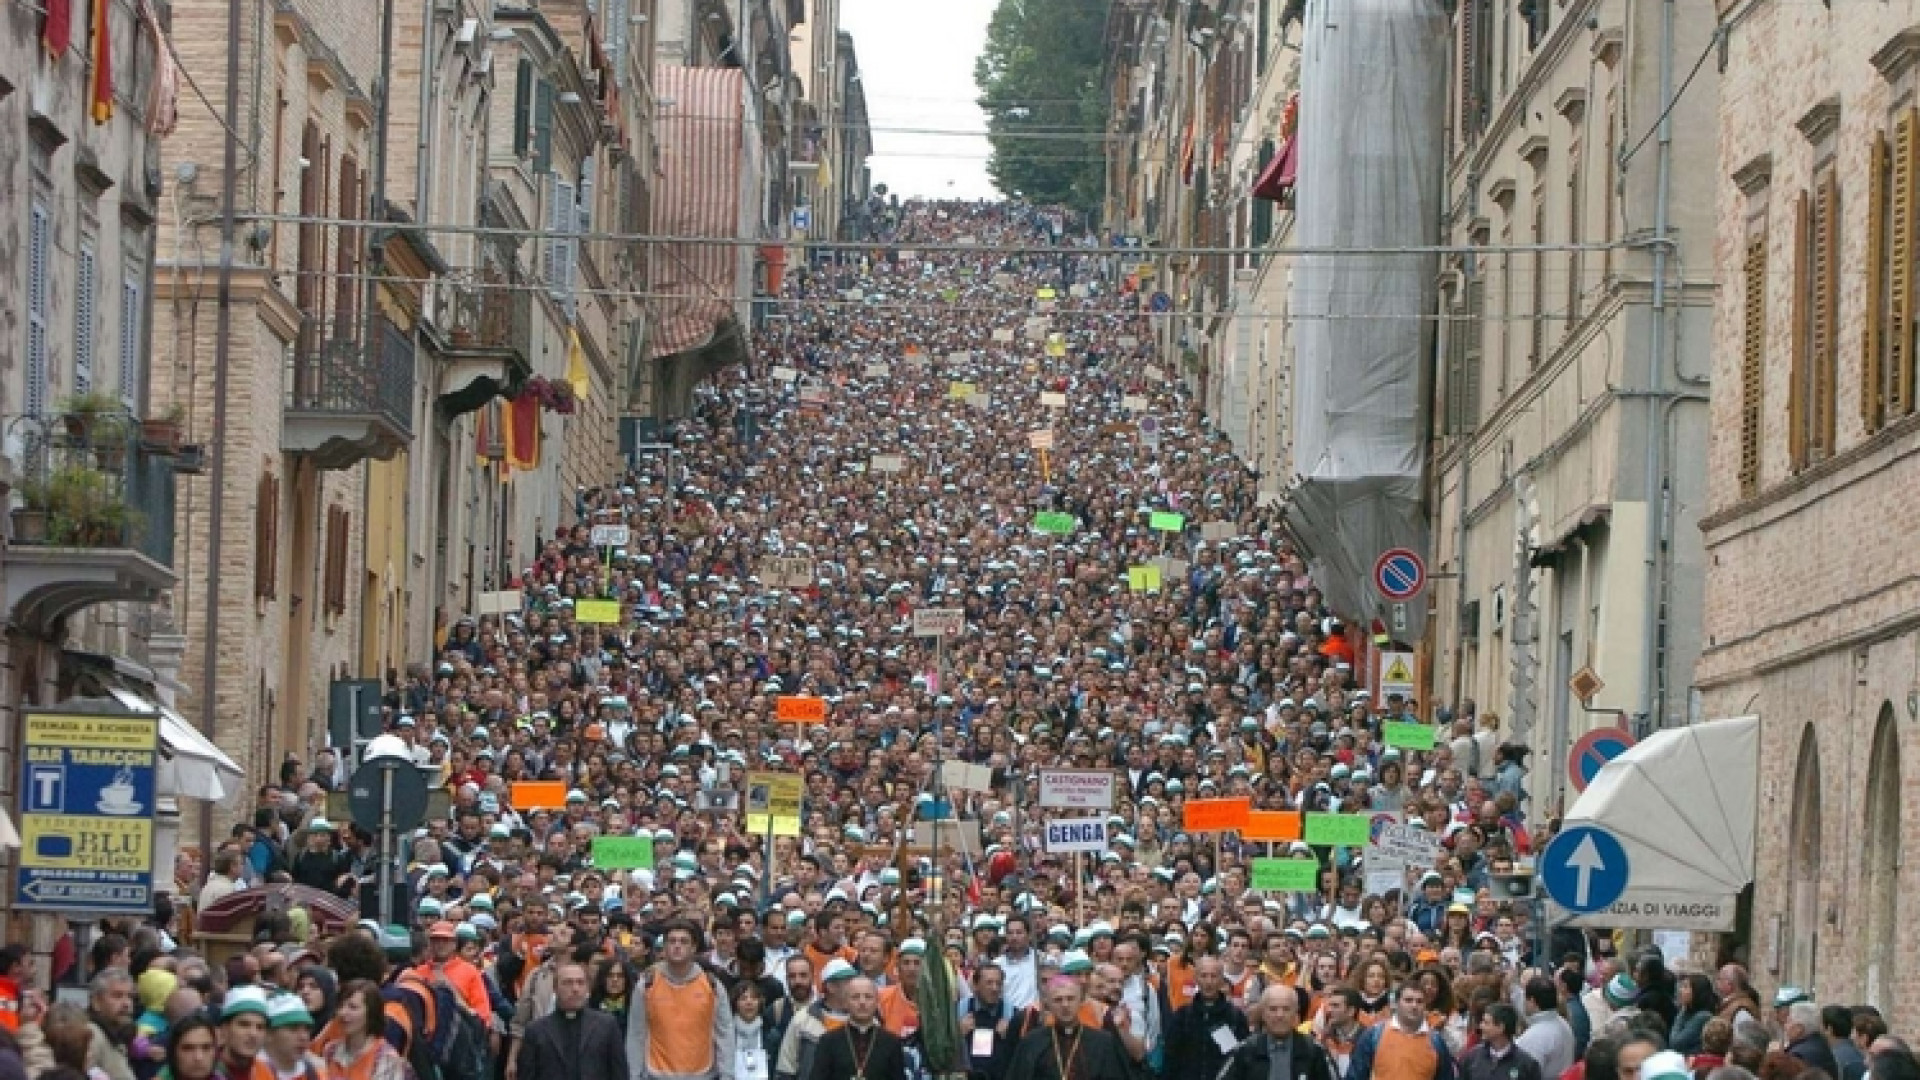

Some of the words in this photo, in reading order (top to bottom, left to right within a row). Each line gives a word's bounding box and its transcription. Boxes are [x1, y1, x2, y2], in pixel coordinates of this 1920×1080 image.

[85, 724, 92, 732] A
[28, 747, 62, 762] BAR
[69, 749, 152, 766] TABACCHI
[35, 772, 60, 806] T
[32, 817, 142, 831] VIDEOTECA
[1049, 823, 1104, 843] GENGA
[77, 832, 142, 854] BLU
[77, 852, 142, 867] video
[1643, 903, 1659, 915] DI
[1664, 903, 1719, 917] VIAGGI
